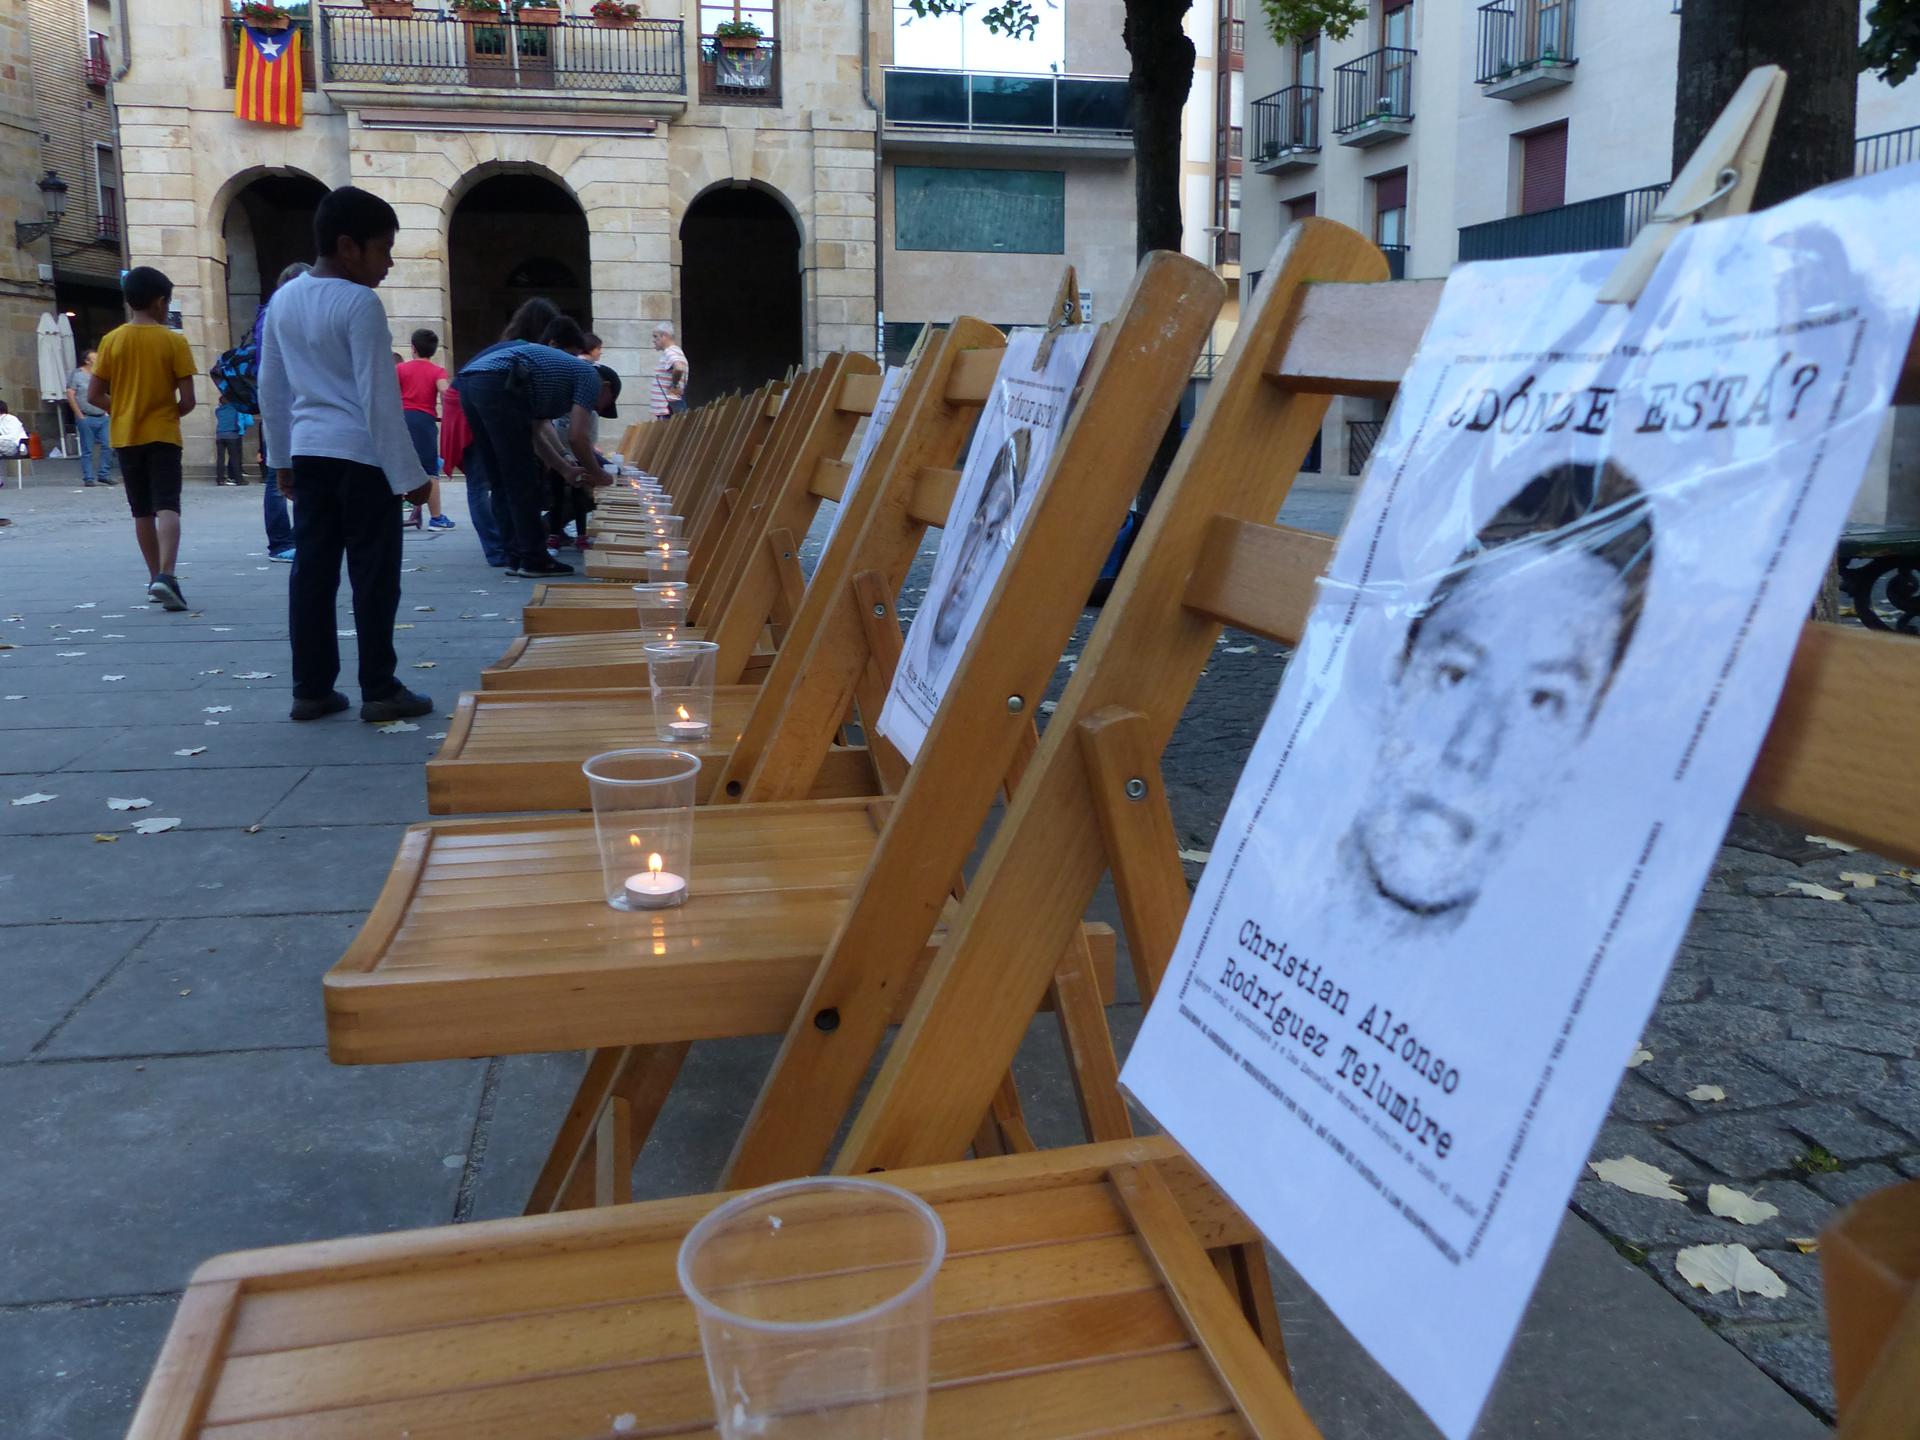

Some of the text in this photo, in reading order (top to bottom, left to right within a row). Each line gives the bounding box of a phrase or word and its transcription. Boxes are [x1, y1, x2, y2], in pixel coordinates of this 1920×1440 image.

[1634, 350, 1820, 434] ESTÁ?
[1219, 957, 1329, 1057] Rodríguez
[1335, 1044, 1454, 1160] Telumbre
[1238, 918, 1461, 1096] Christian Alfonso
